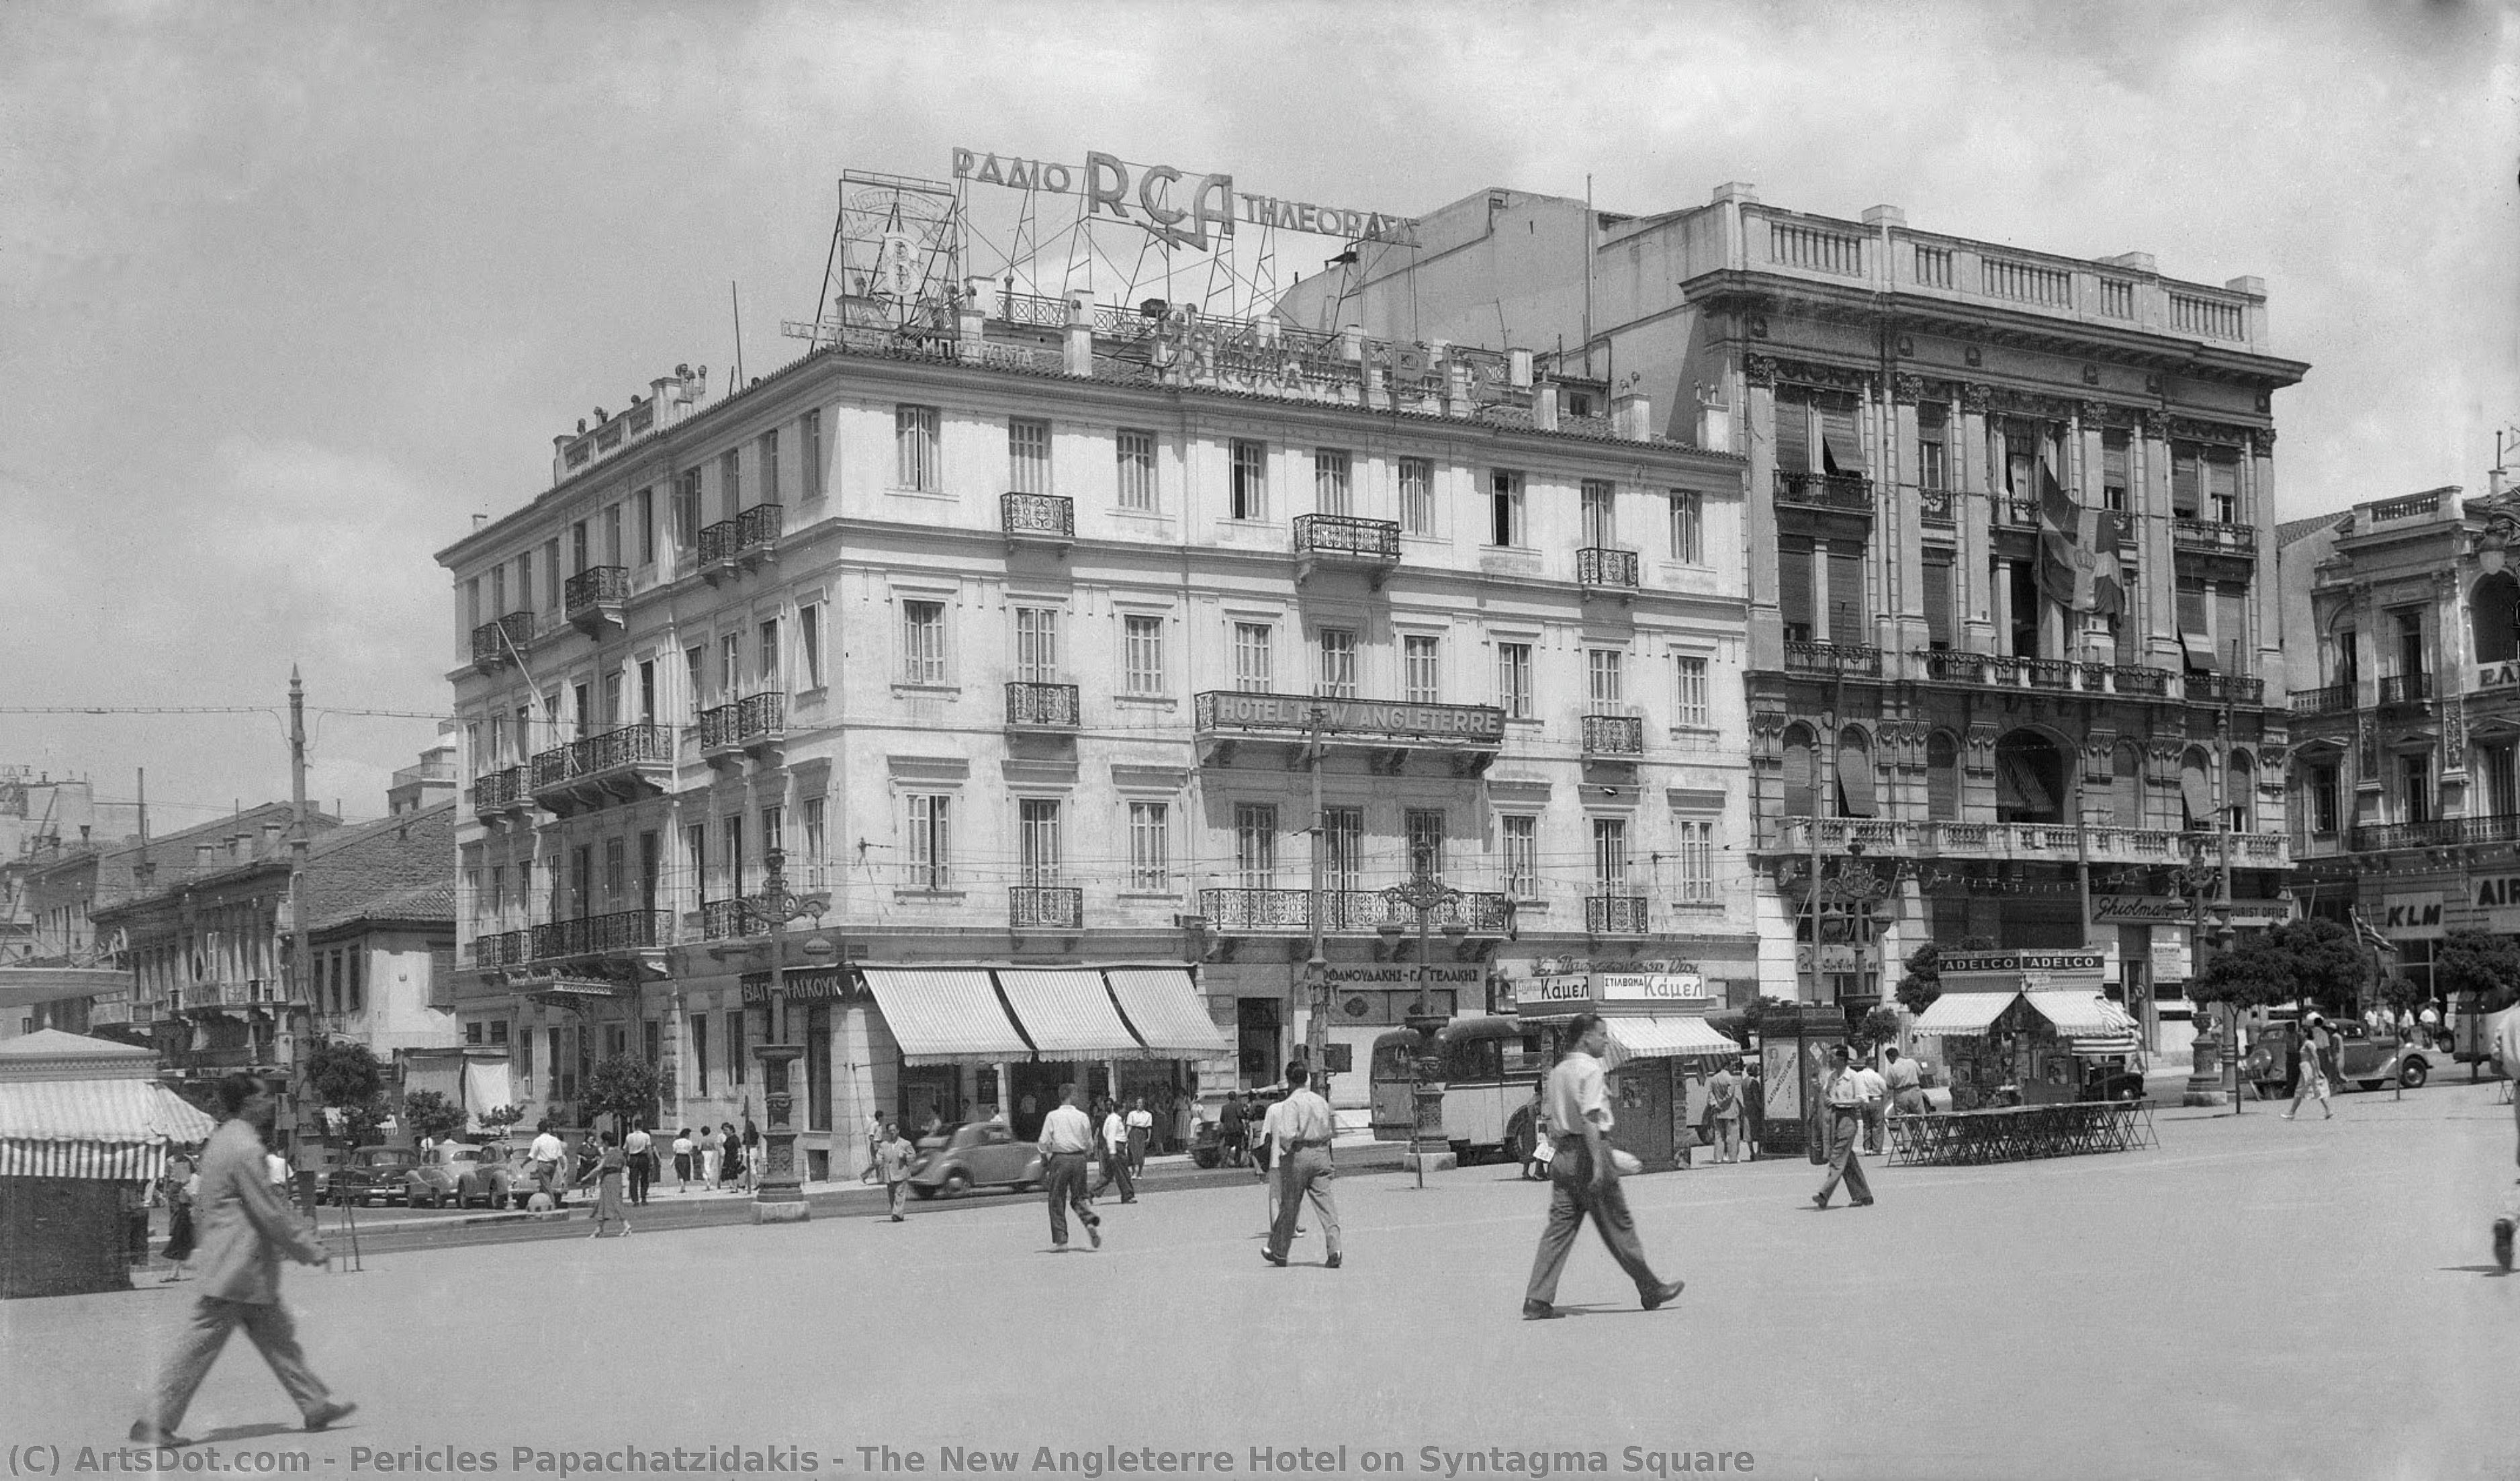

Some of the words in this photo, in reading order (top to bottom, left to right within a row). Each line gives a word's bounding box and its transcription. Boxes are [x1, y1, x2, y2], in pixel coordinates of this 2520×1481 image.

[953, 146, 1071, 193] ΡΑΔΙΟ
[1088, 150, 1234, 250] RCA
[1220, 696, 1289, 723] HOTEL
[2261, 907, 2290, 919] OFFICE
[2388, 905, 2441, 928] KLM
[1541, 976, 1589, 1000] Κάμελ
[1605, 977, 1644, 987] ΣΤΙΛΒΩΜΑ
[1644, 975, 1703, 997] Κάμελ
